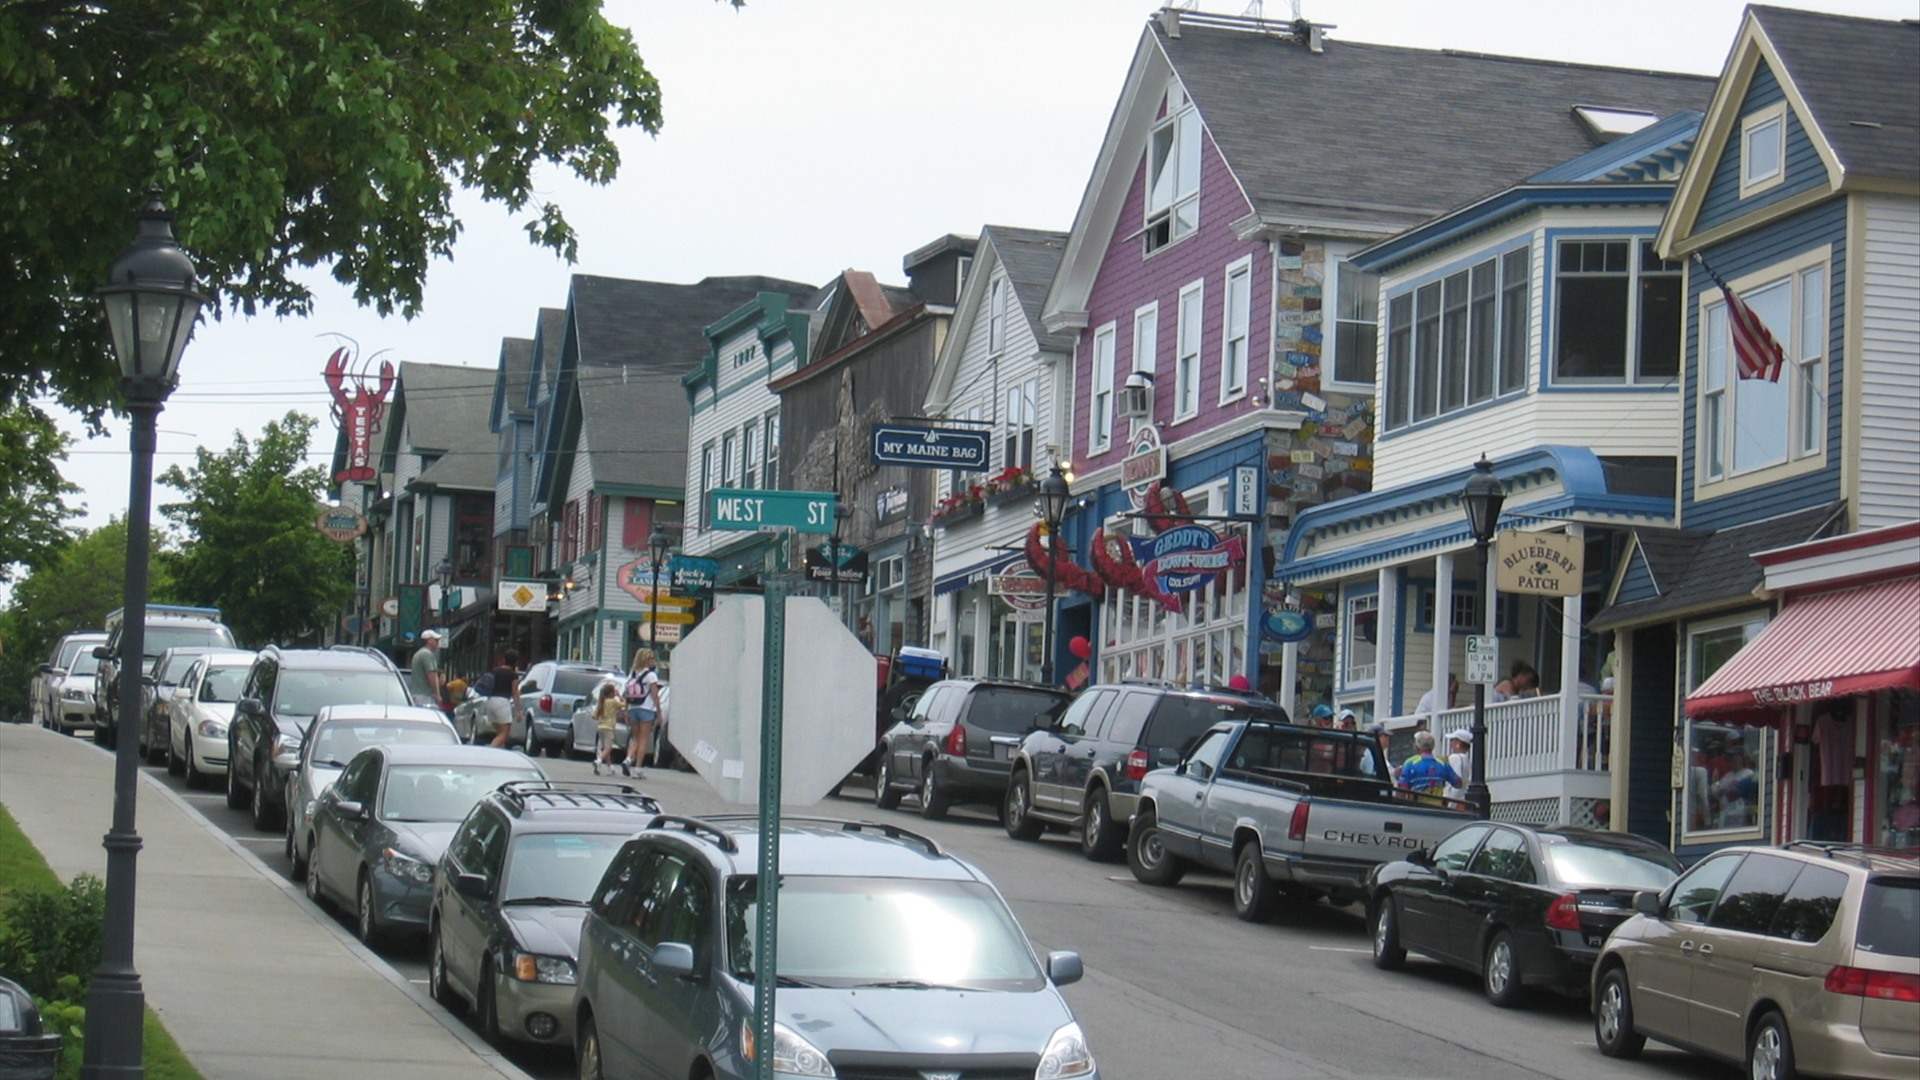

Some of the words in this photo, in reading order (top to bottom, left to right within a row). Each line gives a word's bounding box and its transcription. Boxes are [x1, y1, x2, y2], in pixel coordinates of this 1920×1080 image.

[354, 406, 368, 467] TESTA'S
[883, 442, 903, 453] MY
[907, 443, 949, 457] MAINE
[952, 446, 977, 459] BAG
[1242, 475, 1251, 512] OPEN
[717, 498, 764, 522] WEST
[807, 501, 827, 525] ST
[1154, 529, 1210, 556] GEDDY'S
[1535, 537, 1547, 545] The
[1503, 546, 1577, 574] BLUEBERRY
[811, 565, 863, 578] Touraline
[1518, 576, 1560, 590] PATCH
[1469, 638, 1476, 651] 2
[1470, 654, 1479, 662] 10
[1482, 654, 1494, 662] AM
[1477, 663, 1487, 672] TO
[1470, 672, 1476, 680] 6
[1481, 672, 1493, 681] PM
[1752, 688, 1775, 704] THE
[1773, 684, 1807, 702] BLACK
[1808, 681, 1833, 699] BEAR
[1324, 829, 1438, 851] CHEVROL
